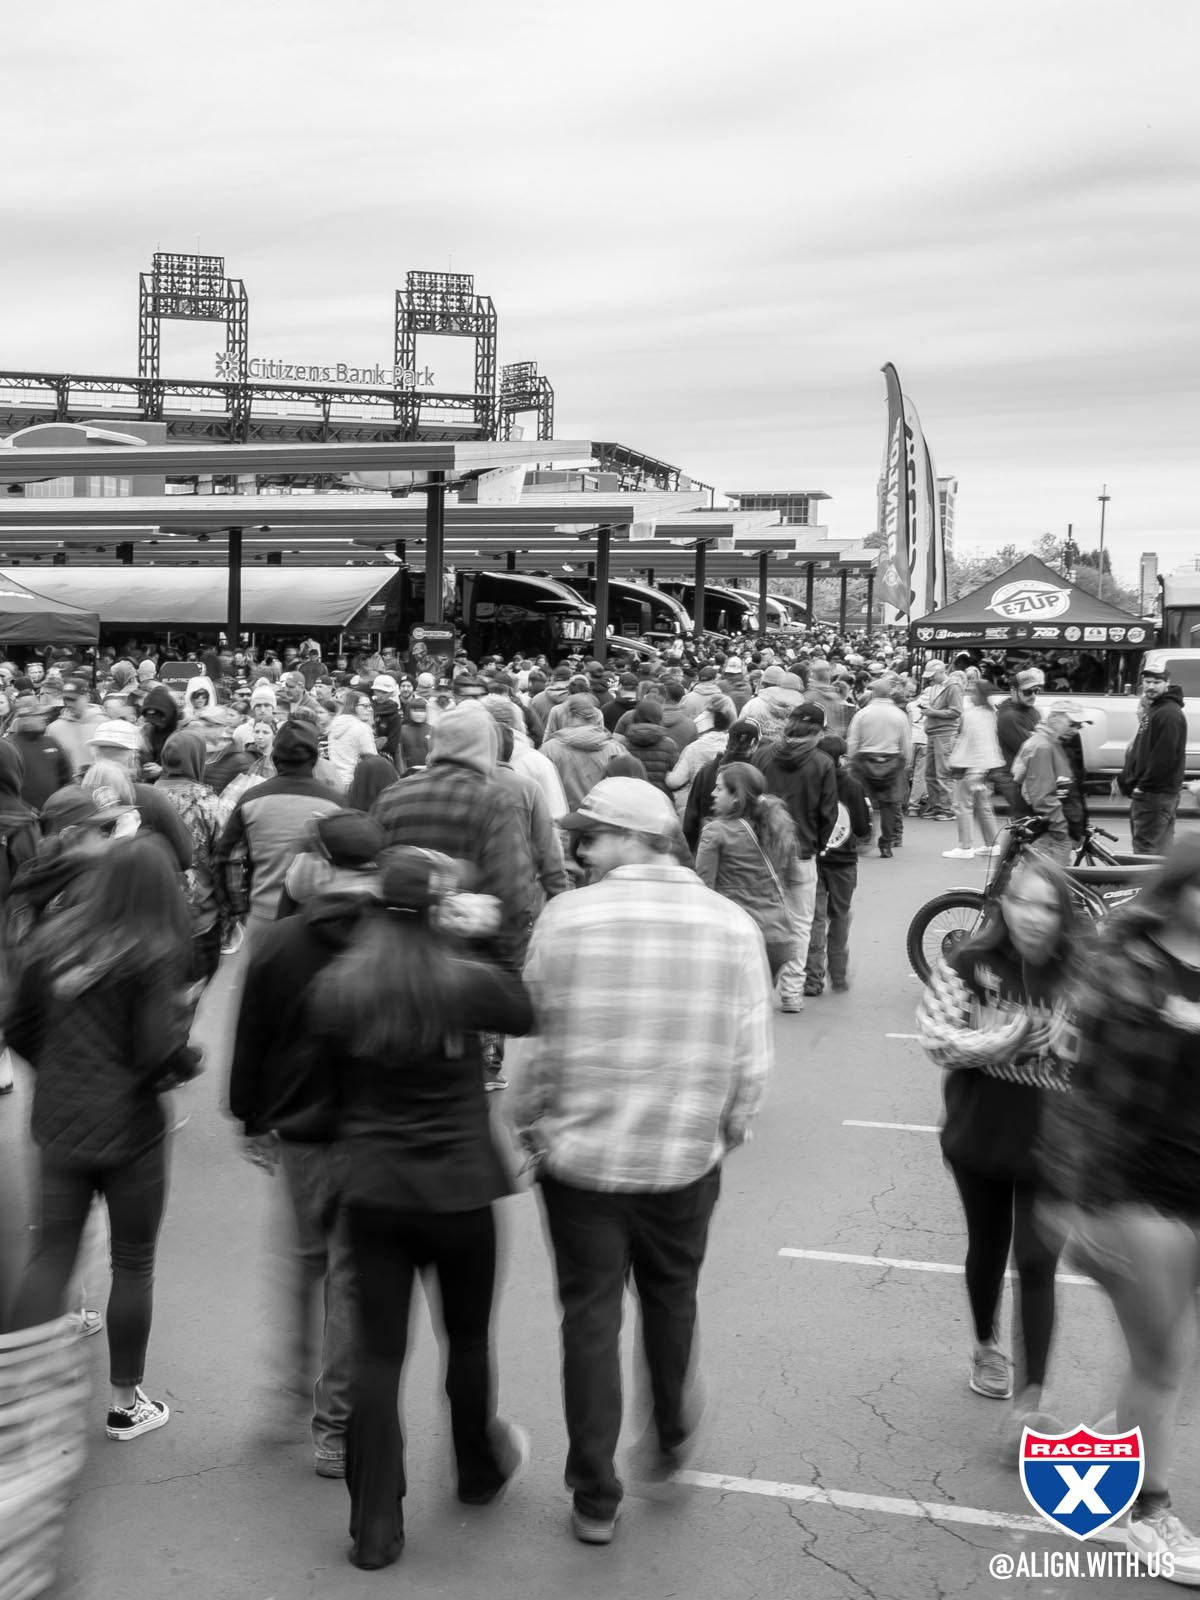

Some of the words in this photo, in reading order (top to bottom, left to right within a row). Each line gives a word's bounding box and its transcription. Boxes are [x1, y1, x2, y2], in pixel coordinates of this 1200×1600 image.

[248, 357, 330, 381] Citizens
[336, 362, 386, 384] Bank
[392, 365, 435, 386] Park
